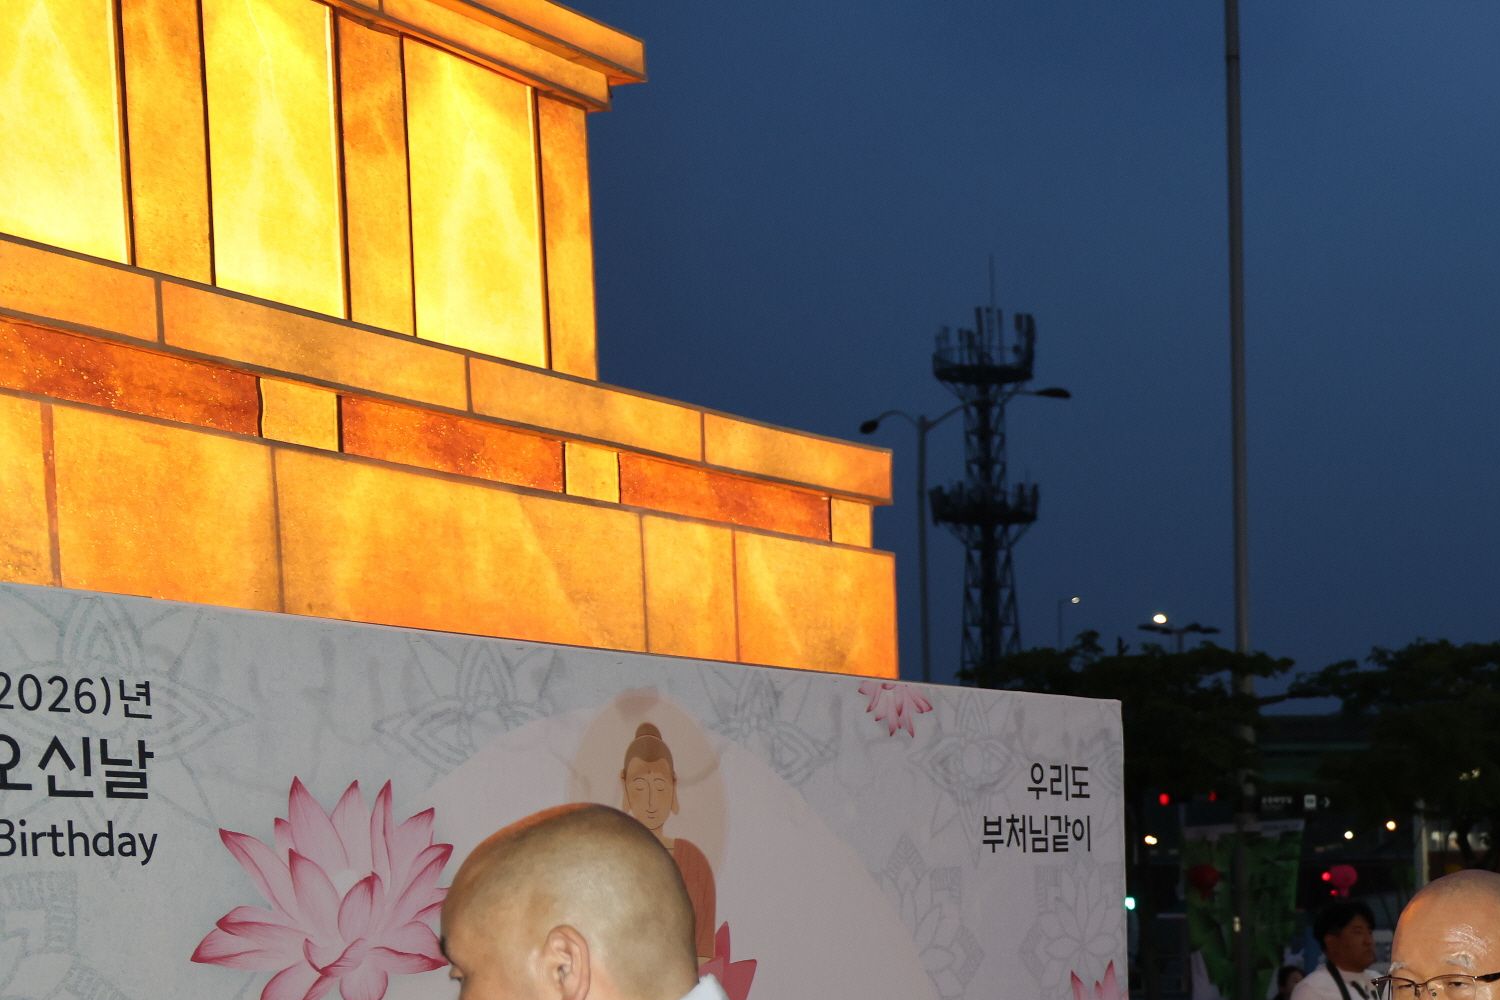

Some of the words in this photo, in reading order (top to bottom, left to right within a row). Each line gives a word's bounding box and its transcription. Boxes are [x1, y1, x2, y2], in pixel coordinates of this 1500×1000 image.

[1027, 762, 1091, 802] 우리도
[0, 818, 158, 866] Birthday
[982, 813, 1091, 853] 부처님같이
